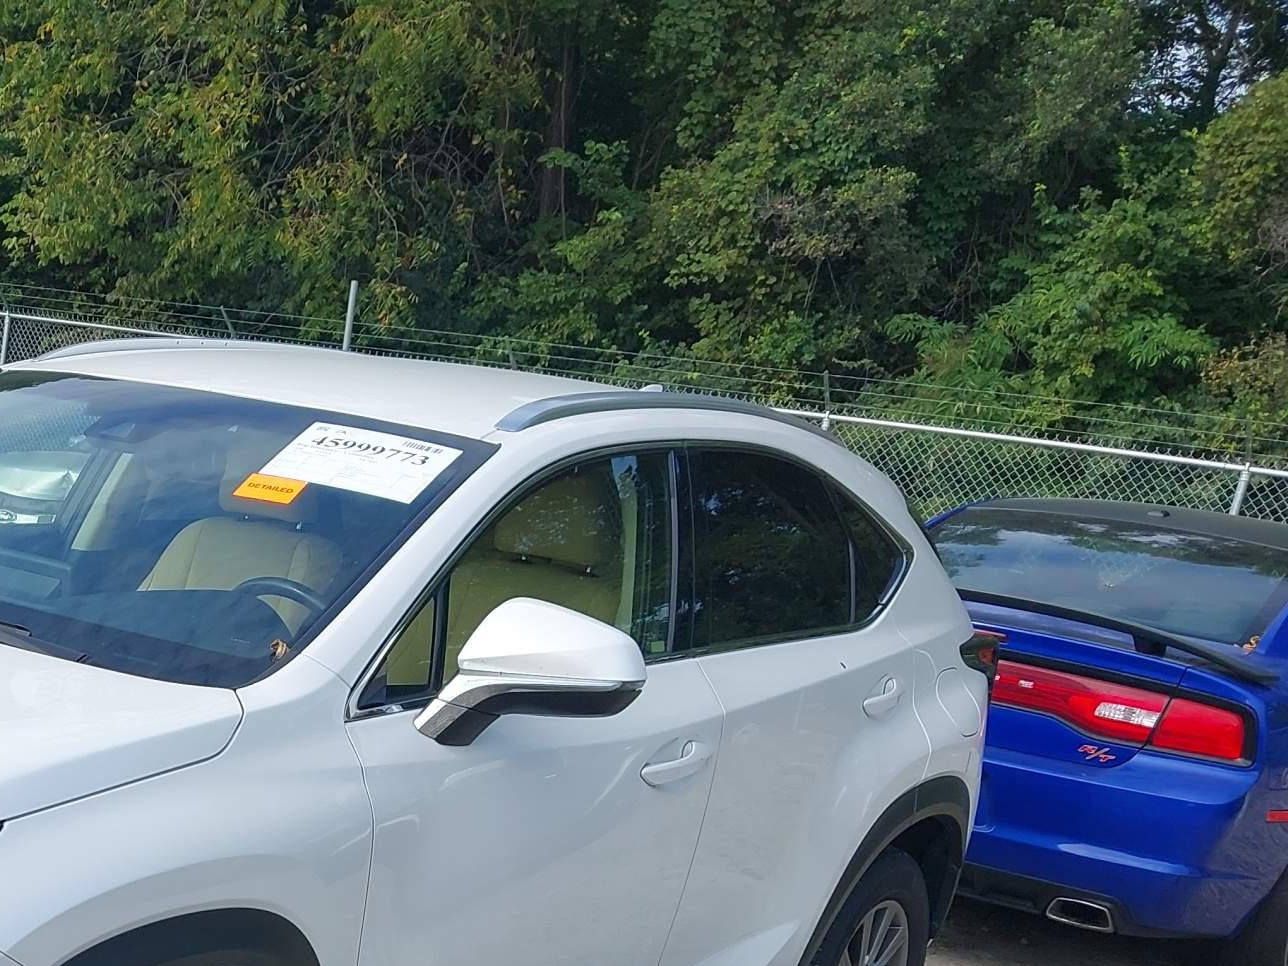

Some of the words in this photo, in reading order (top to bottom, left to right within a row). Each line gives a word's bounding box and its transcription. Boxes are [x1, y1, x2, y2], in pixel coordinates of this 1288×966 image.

[311, 436, 430, 466] 45999773
[247, 481, 294, 494] DETAILED
[1077, 744, 1117, 763] R/T
